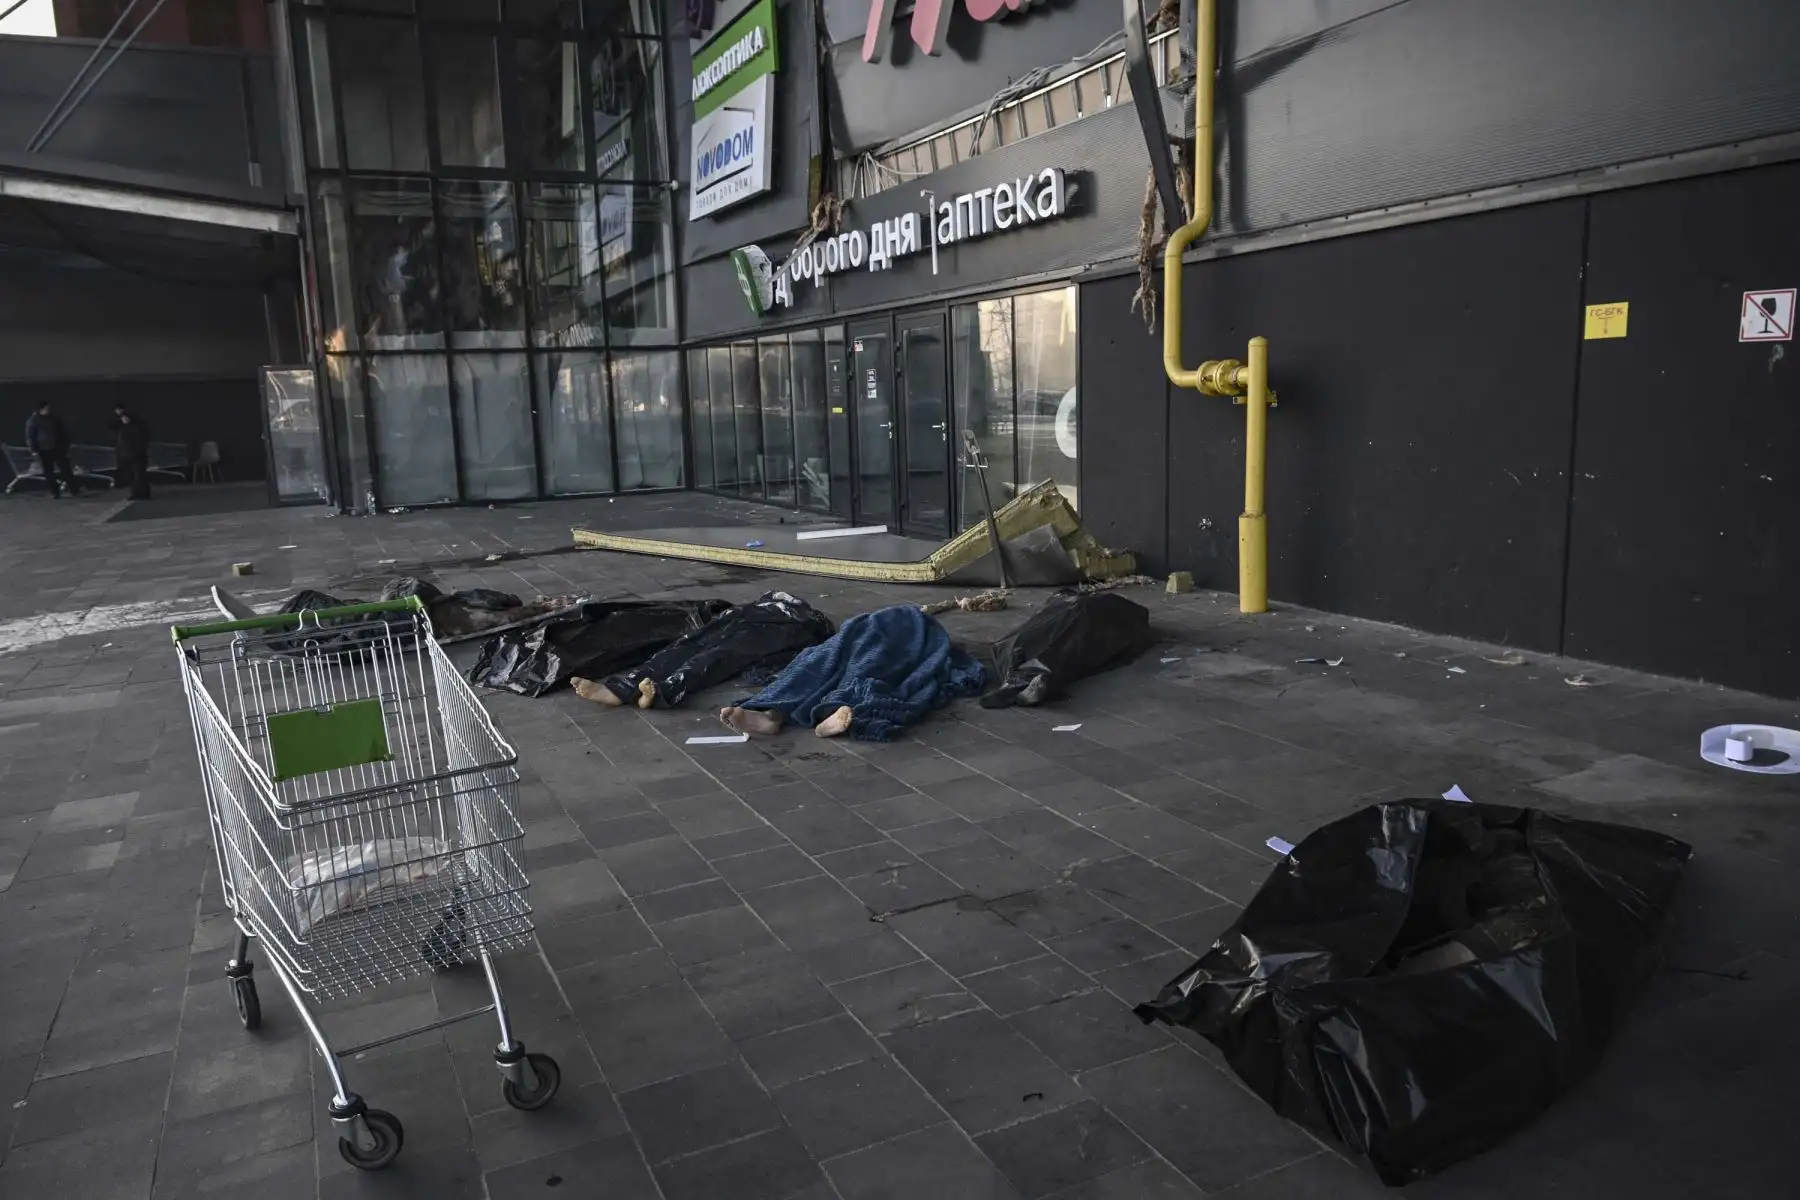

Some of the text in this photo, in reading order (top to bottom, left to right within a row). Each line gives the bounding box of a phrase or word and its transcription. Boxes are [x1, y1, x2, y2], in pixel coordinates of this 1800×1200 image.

[697, 126, 754, 183] NOVODOM
[869, 212, 918, 272] дня
[938, 167, 1061, 244] аптека
